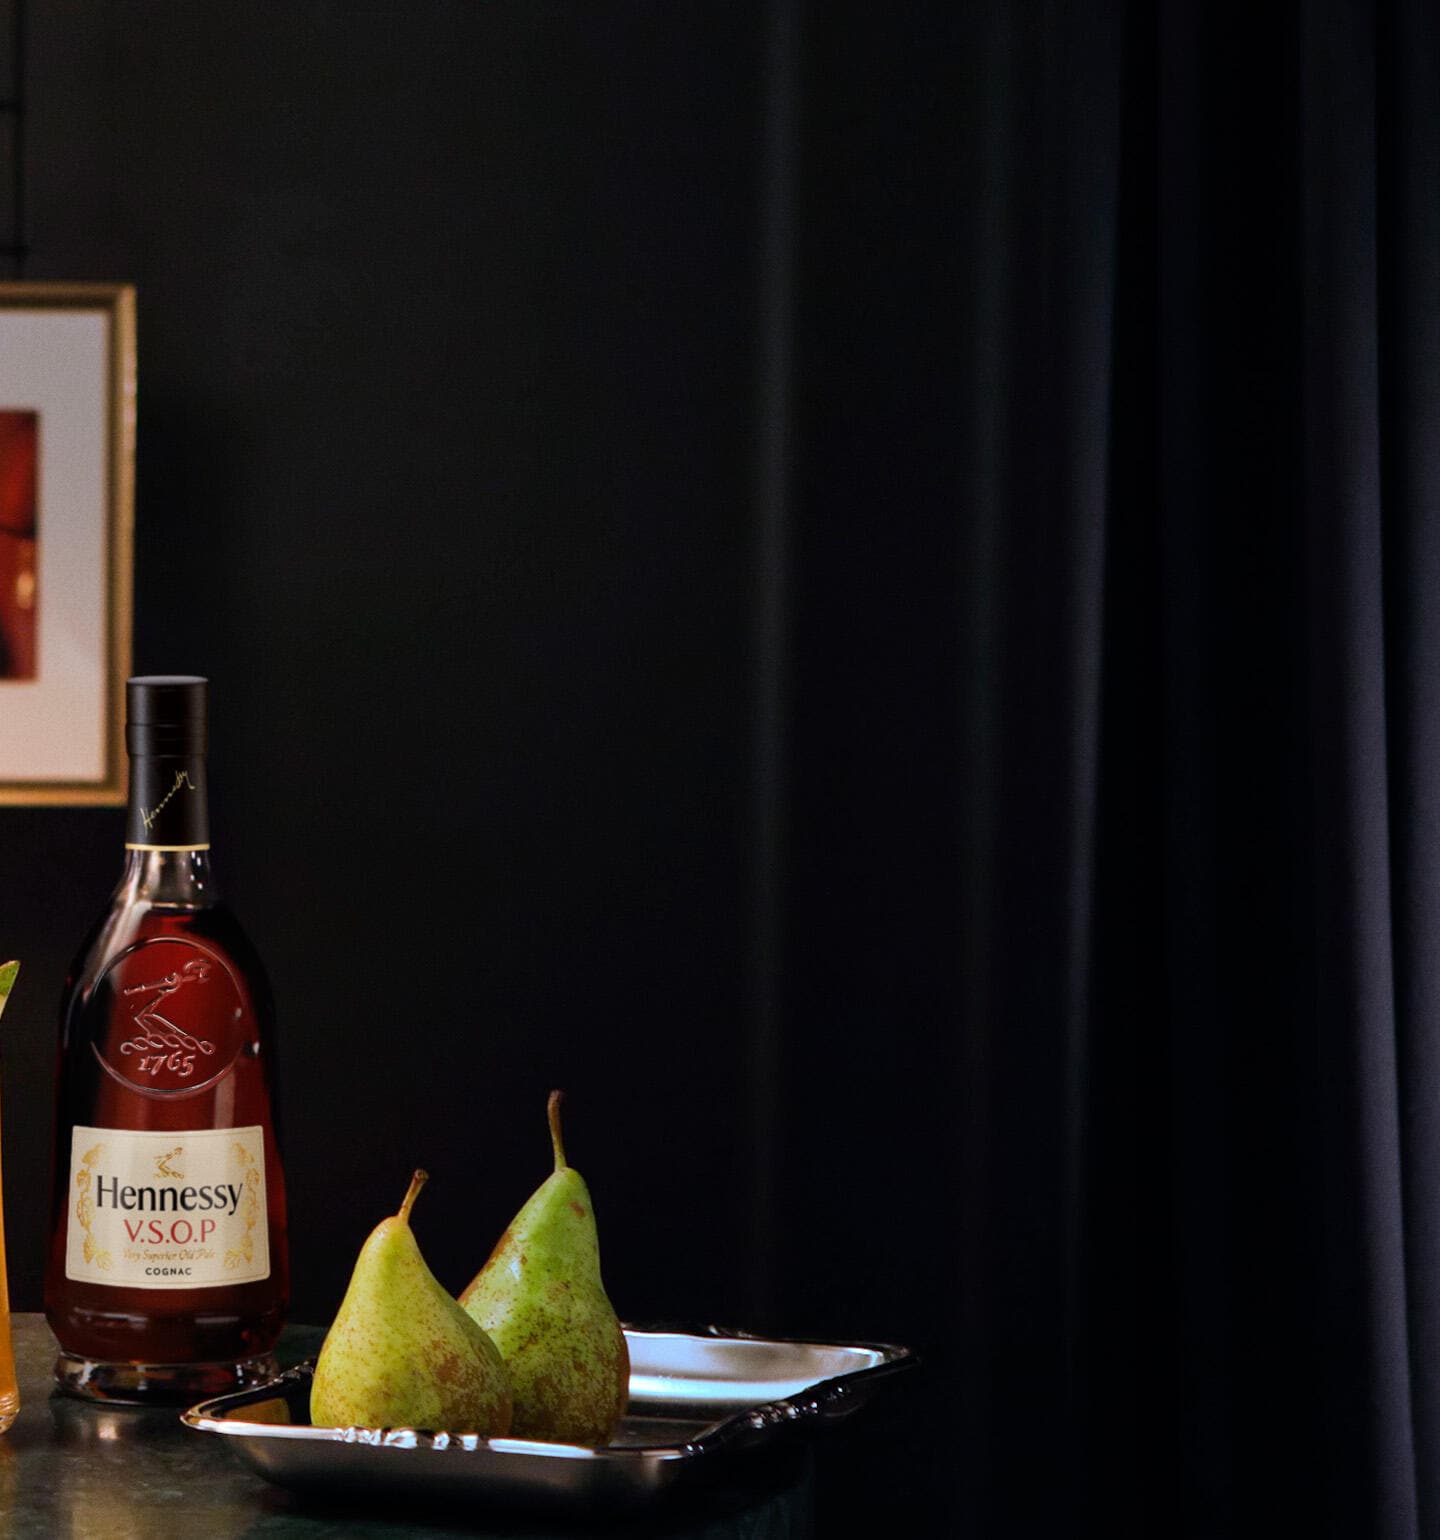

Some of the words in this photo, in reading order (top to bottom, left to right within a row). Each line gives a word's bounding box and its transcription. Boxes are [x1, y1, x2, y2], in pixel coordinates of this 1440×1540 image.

[137, 1050, 196, 1077] 1765
[96, 1174, 244, 1216] Hennessy
[123, 1218, 216, 1245] V.S.O.P
[145, 1267, 192, 1276] COGNAC
